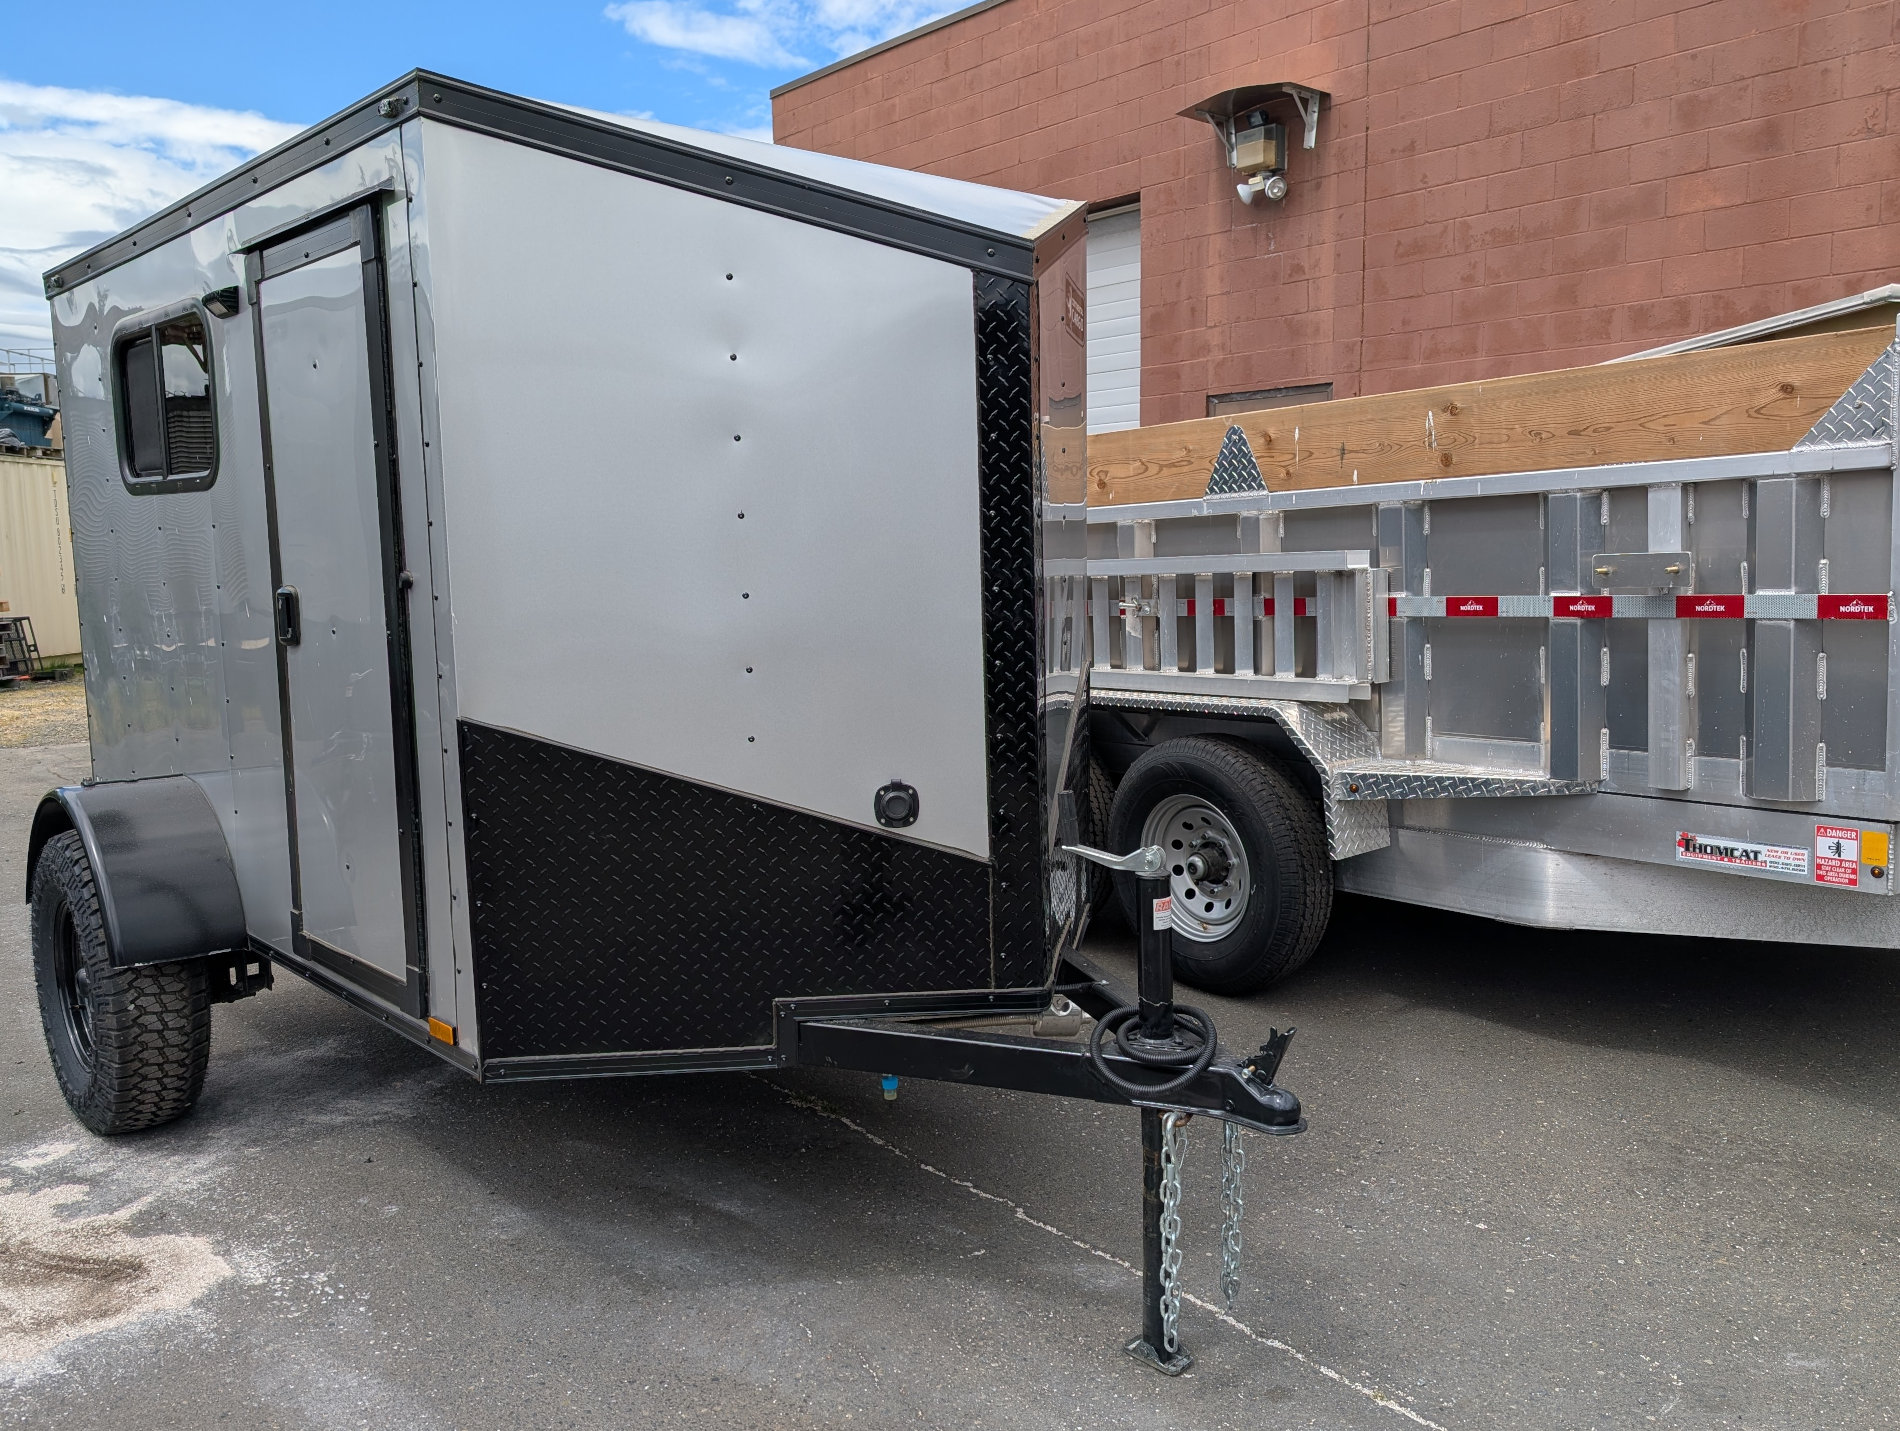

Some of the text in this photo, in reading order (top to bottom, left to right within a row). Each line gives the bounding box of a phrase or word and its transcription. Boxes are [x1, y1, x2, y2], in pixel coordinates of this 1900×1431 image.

[1570, 604, 1595, 612] NORDTEK
[1839, 605, 1874, 613] NORDTEK
[1826, 829, 1857, 839] DANGER
[1681, 838, 1762, 861] THOMCAT
[1682, 852, 1720, 862] EQUIPMENT
[1731, 858, 1766, 867] TRAILERS
[1816, 858, 1857, 869] HAZARD AREA
